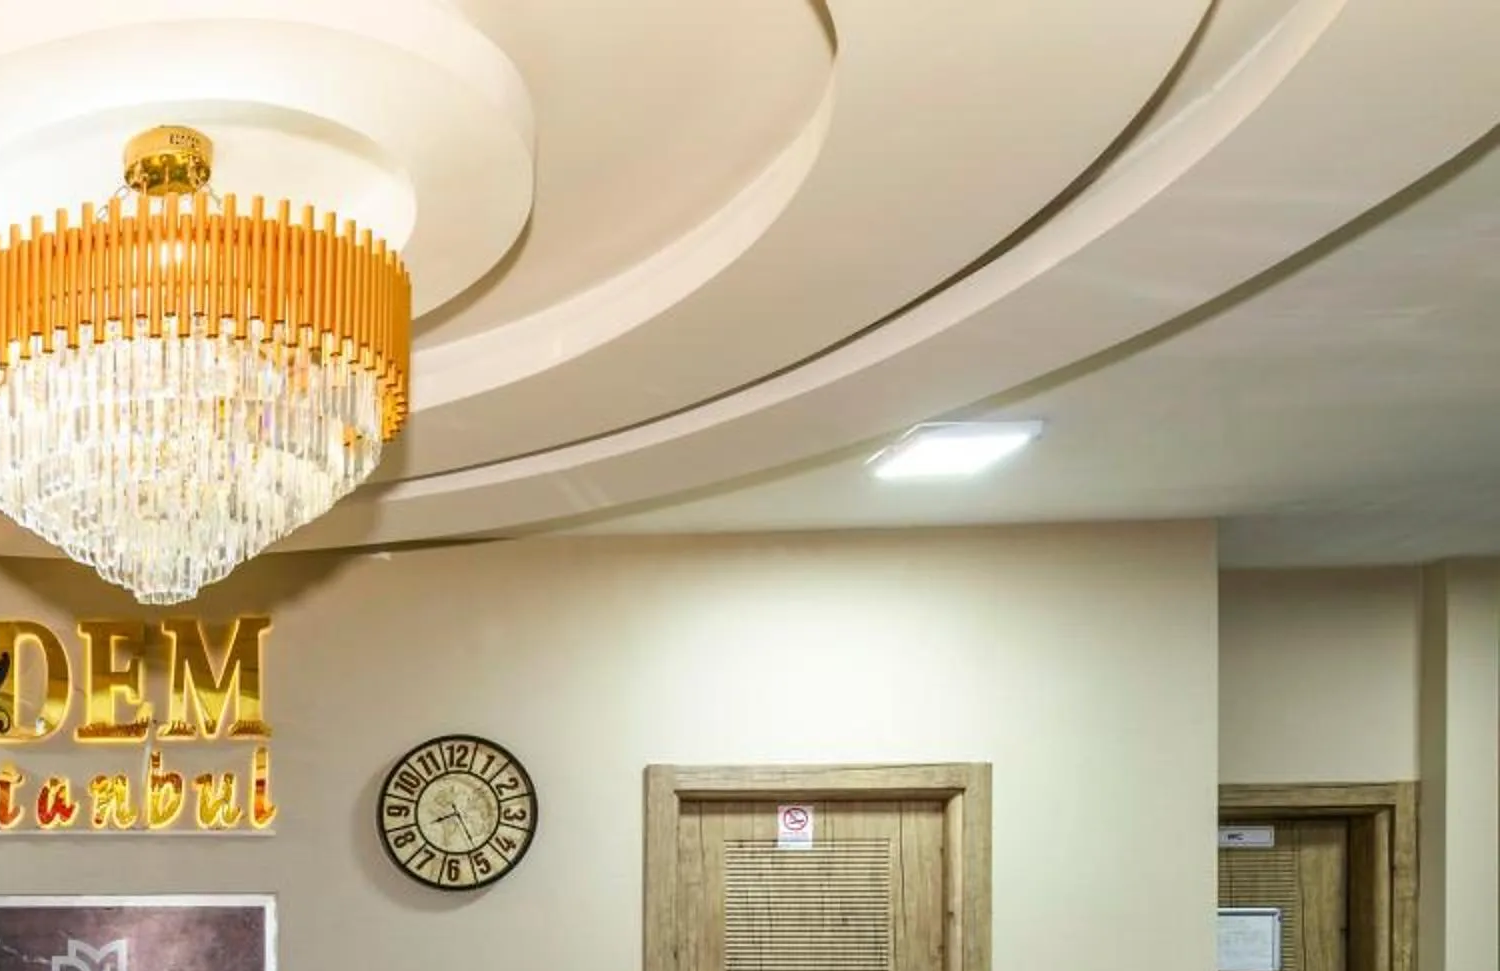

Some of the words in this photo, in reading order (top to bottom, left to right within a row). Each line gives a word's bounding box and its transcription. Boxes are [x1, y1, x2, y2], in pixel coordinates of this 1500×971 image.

[417, 751, 441, 777] 11
[447, 745, 469, 768] 12
[481, 754, 495, 775] 1
[394, 770, 420, 796] 10
[495, 777, 518, 796] 2
[386, 805, 410, 818] 9
[503, 807, 526, 821] 3
[393, 830, 416, 849] 8
[495, 836, 516, 853] 4
[416, 849, 436, 870] 7
[447, 858, 461, 882] 6
[473, 851, 491, 874] 5
